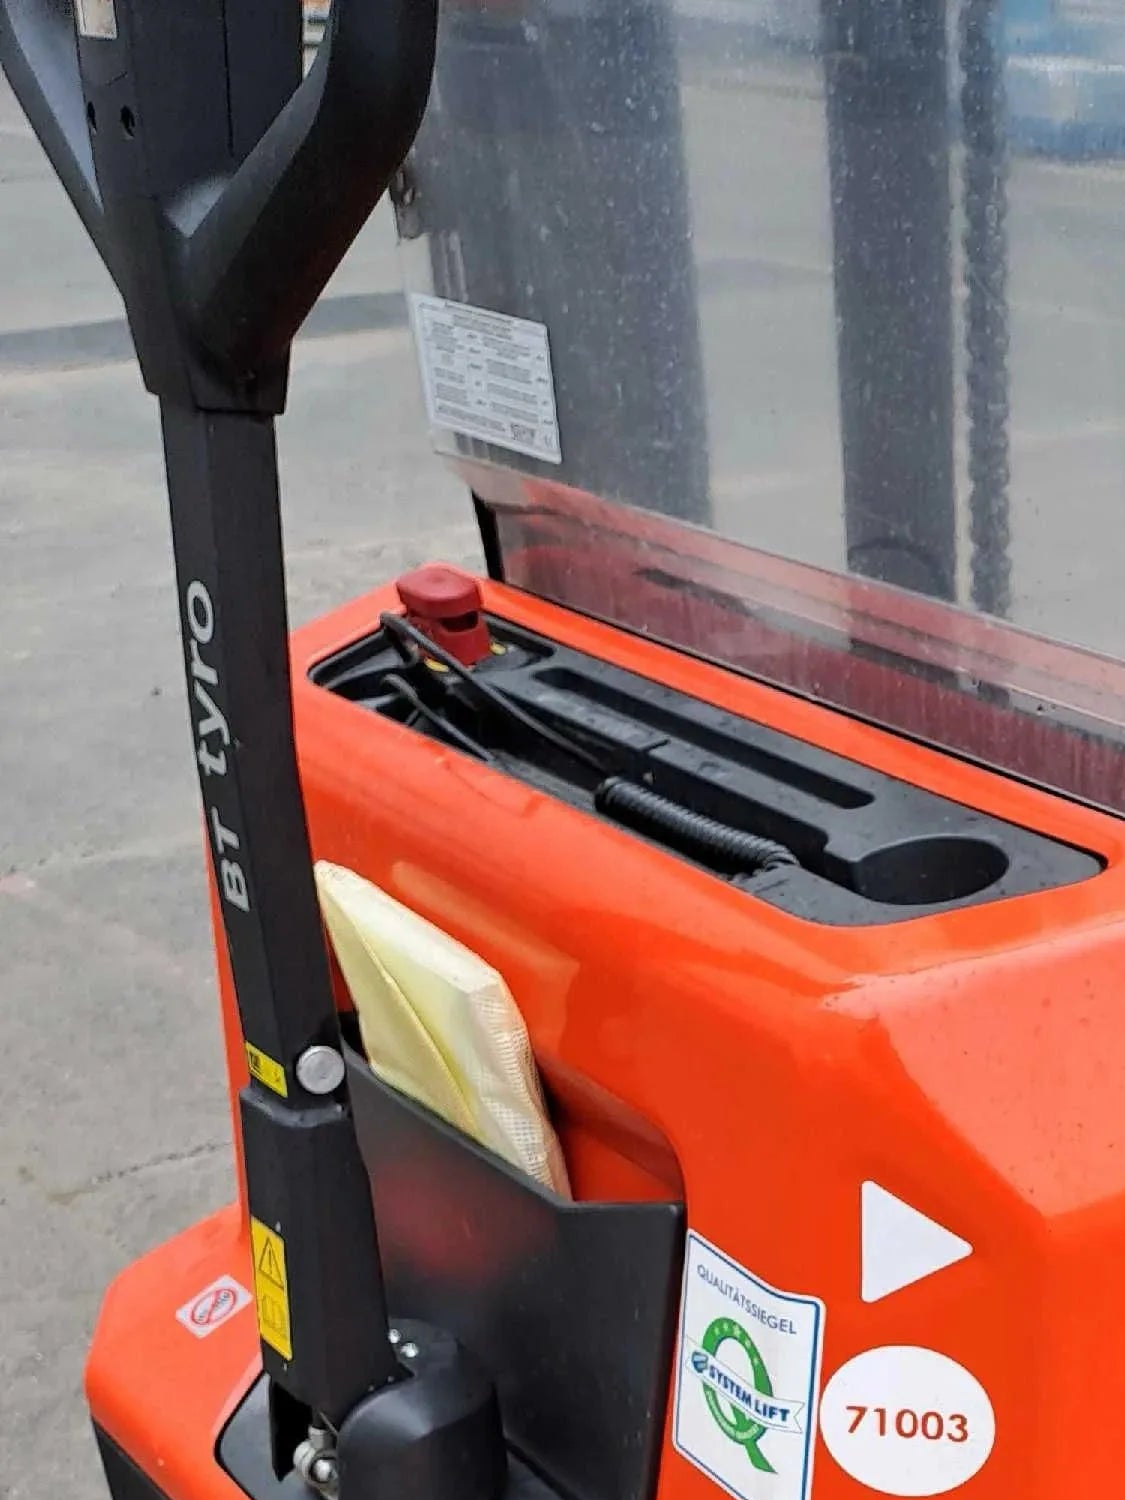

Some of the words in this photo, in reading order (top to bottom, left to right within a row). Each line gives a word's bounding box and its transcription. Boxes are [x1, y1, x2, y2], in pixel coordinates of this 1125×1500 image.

[187, 580, 230, 776] tyro
[210, 805, 250, 913] BT
[697, 1264, 797, 1335] QUALITÄTSSIEGEL
[708, 1364, 753, 1407] SYSTEM
[753, 1398, 791, 1422] LIFT
[845, 1405, 970, 1443] 71003
